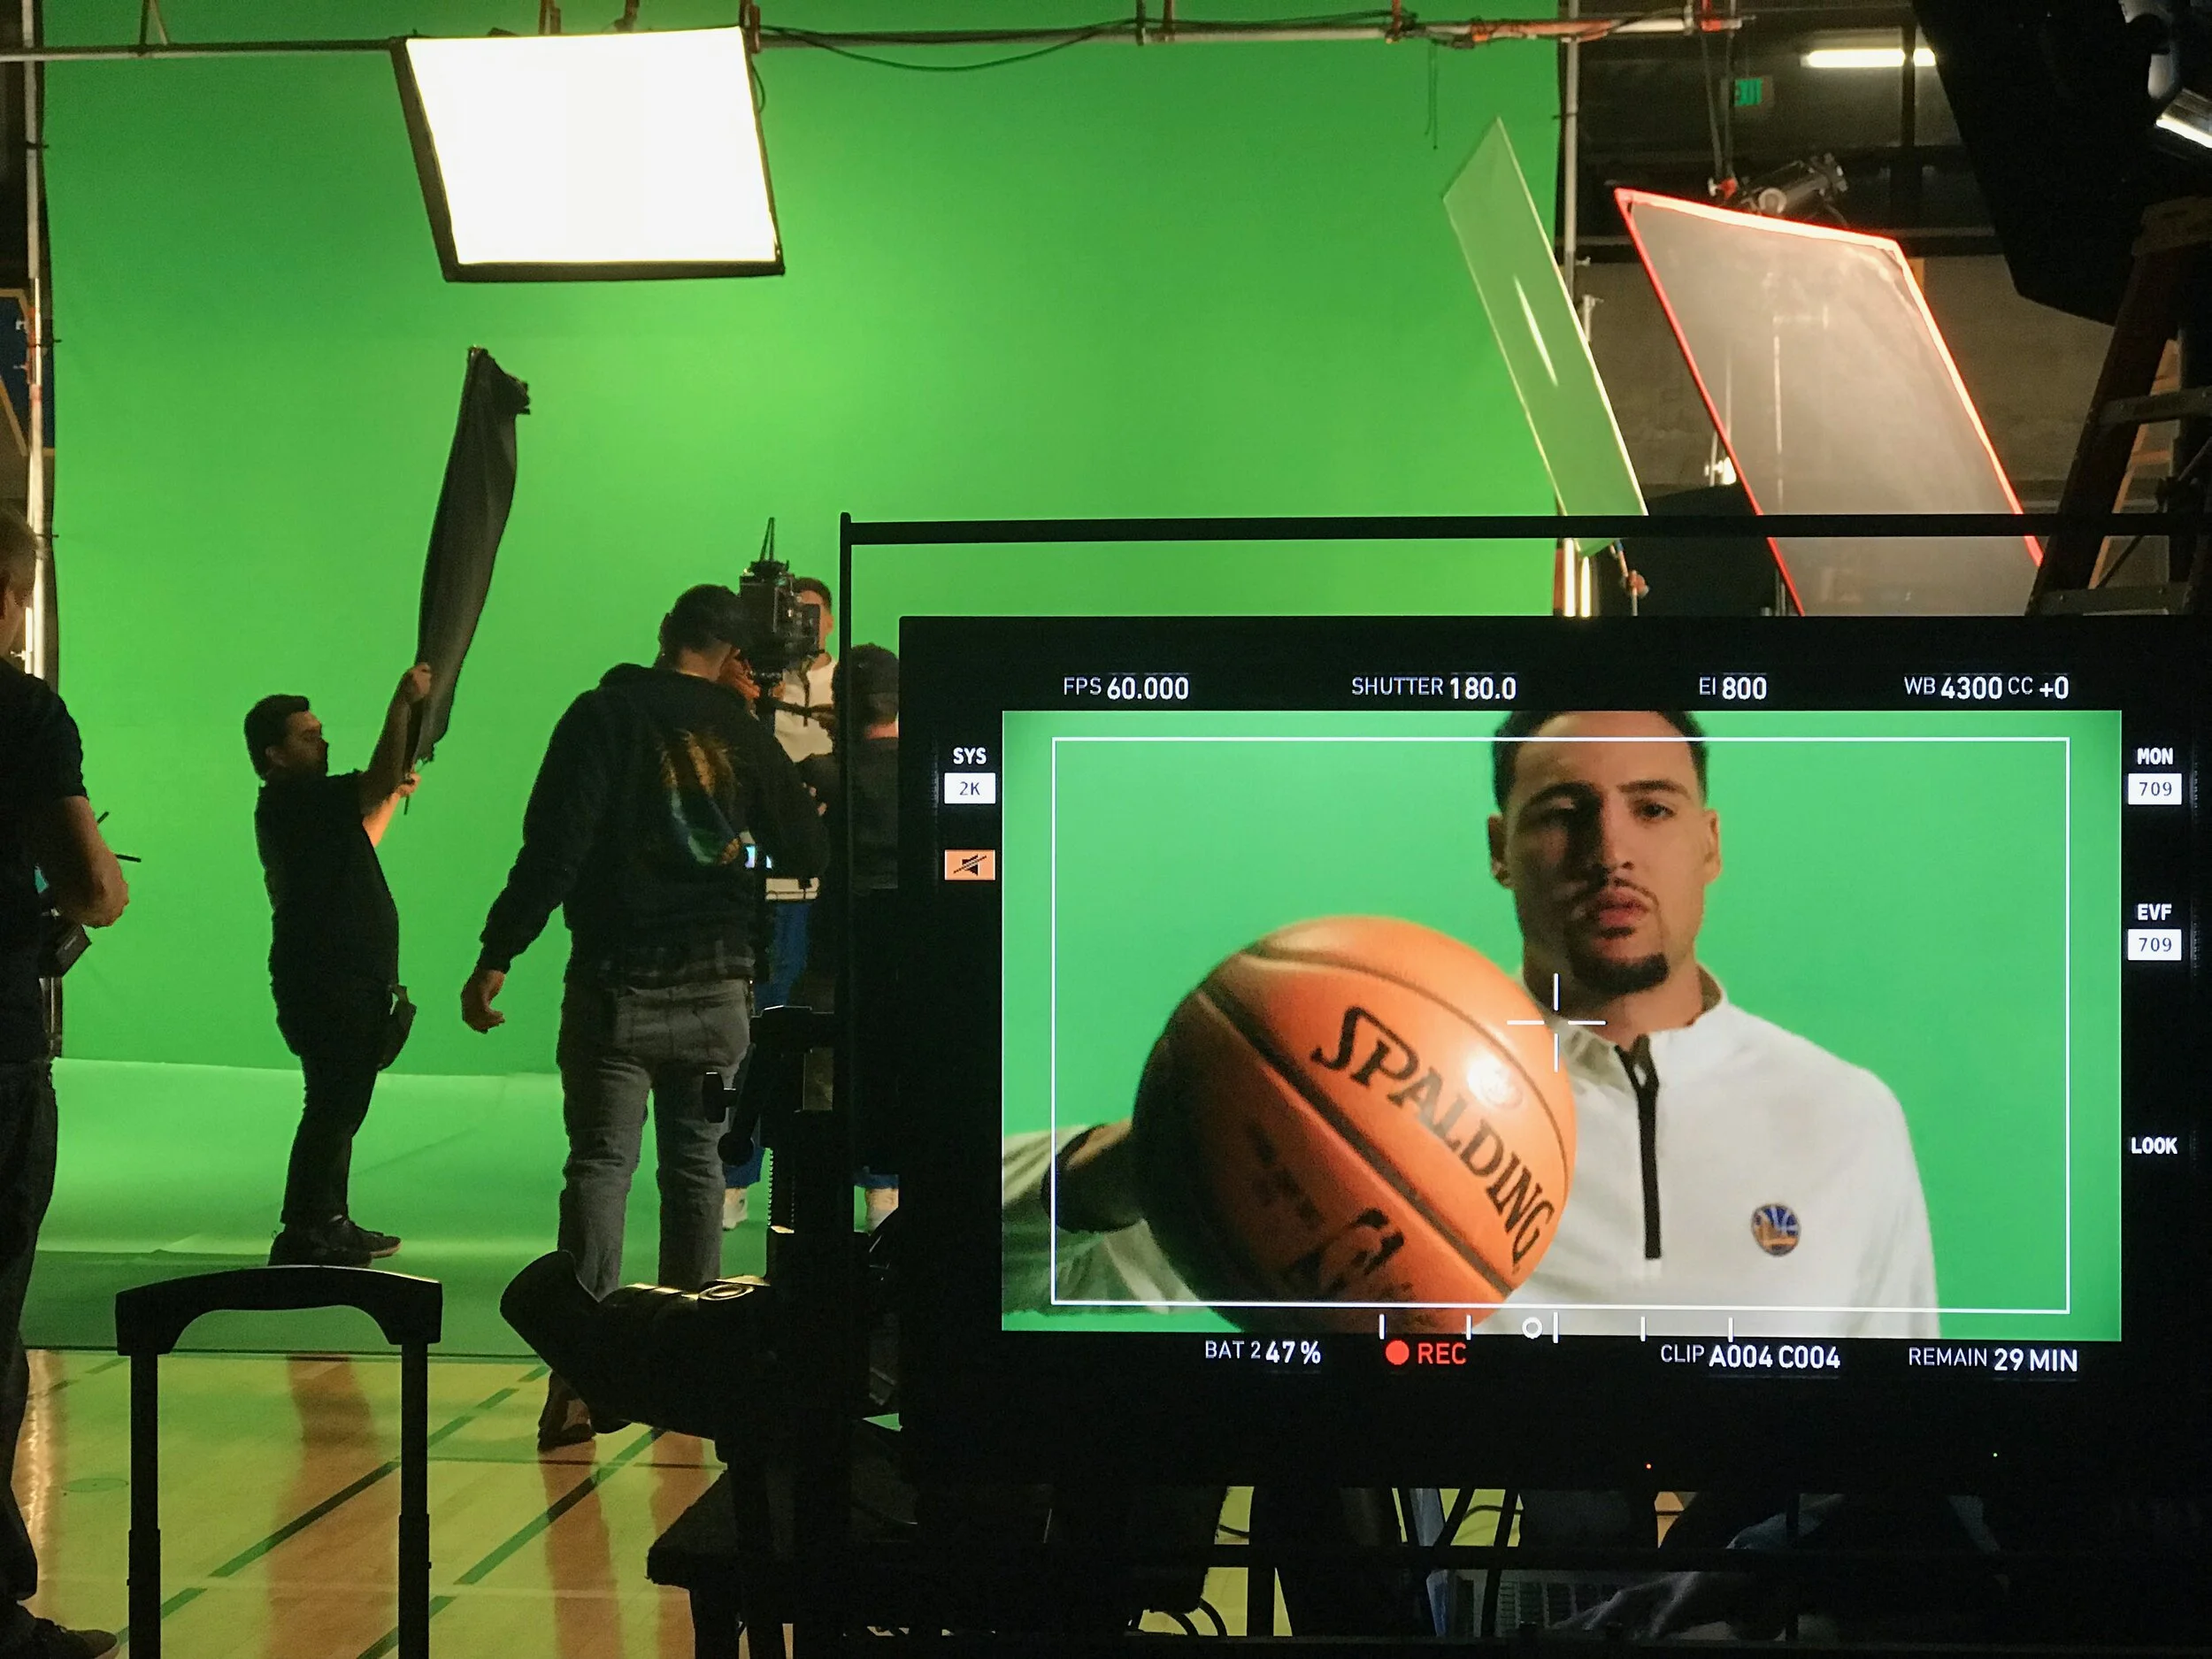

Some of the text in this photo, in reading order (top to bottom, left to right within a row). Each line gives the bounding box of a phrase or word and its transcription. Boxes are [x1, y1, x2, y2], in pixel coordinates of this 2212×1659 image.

[1064, 676, 1189, 701] FPS 60.000
[1351, 676, 1517, 701] SHUTTER 180.0
[1699, 676, 1767, 701] EI 800
[1903, 676, 2070, 700] WB 4300 CC +0
[953, 747, 987, 765] SYS
[2137, 747, 2174, 765] MON
[958, 780, 981, 796] 2K
[2139, 780, 2172, 796] 709
[2137, 902, 2172, 921] EVF
[2139, 937, 2172, 953] 709
[1310, 1006, 1555, 1265] SPALDING
[2131, 1136, 2178, 1155] LOOK
[1205, 1340, 1245, 1359] BAT
[1250, 1340, 1261, 1359] 2
[1417, 1342, 1467, 1364] REC
[1660, 1344, 1841, 1369] CLIP A004 C004
[1909, 1347, 2078, 1372] REMAIN 29 MIN
